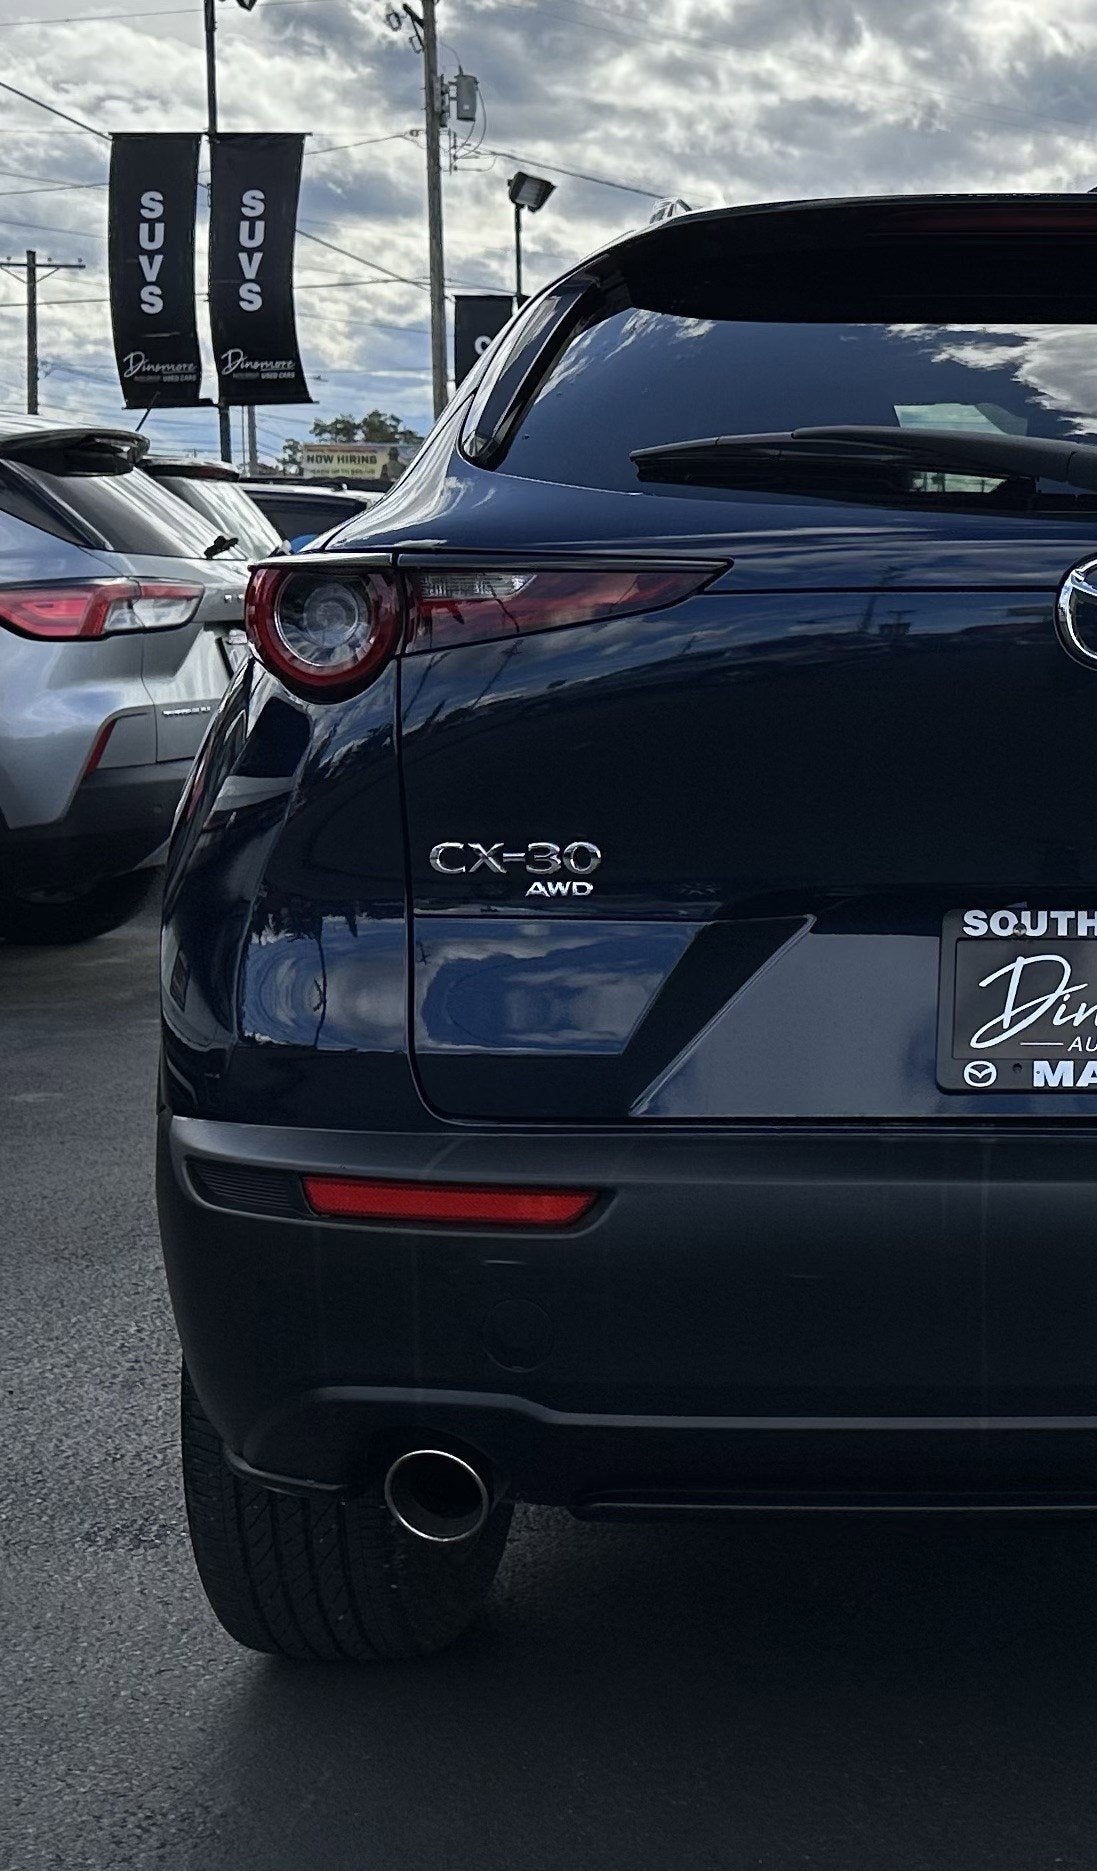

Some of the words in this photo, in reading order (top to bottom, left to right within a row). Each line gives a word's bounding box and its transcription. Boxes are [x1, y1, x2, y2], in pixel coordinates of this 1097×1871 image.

[139, 191, 165, 314] SUVS
[238, 189, 265, 312] SUVS
[123, 351, 198, 378] Dinsmore
[221, 348, 296, 375] Dinsmore
[337, 455, 377, 464] HIRING
[429, 841, 602, 875] CX-30
[525, 881, 594, 898] AWD
